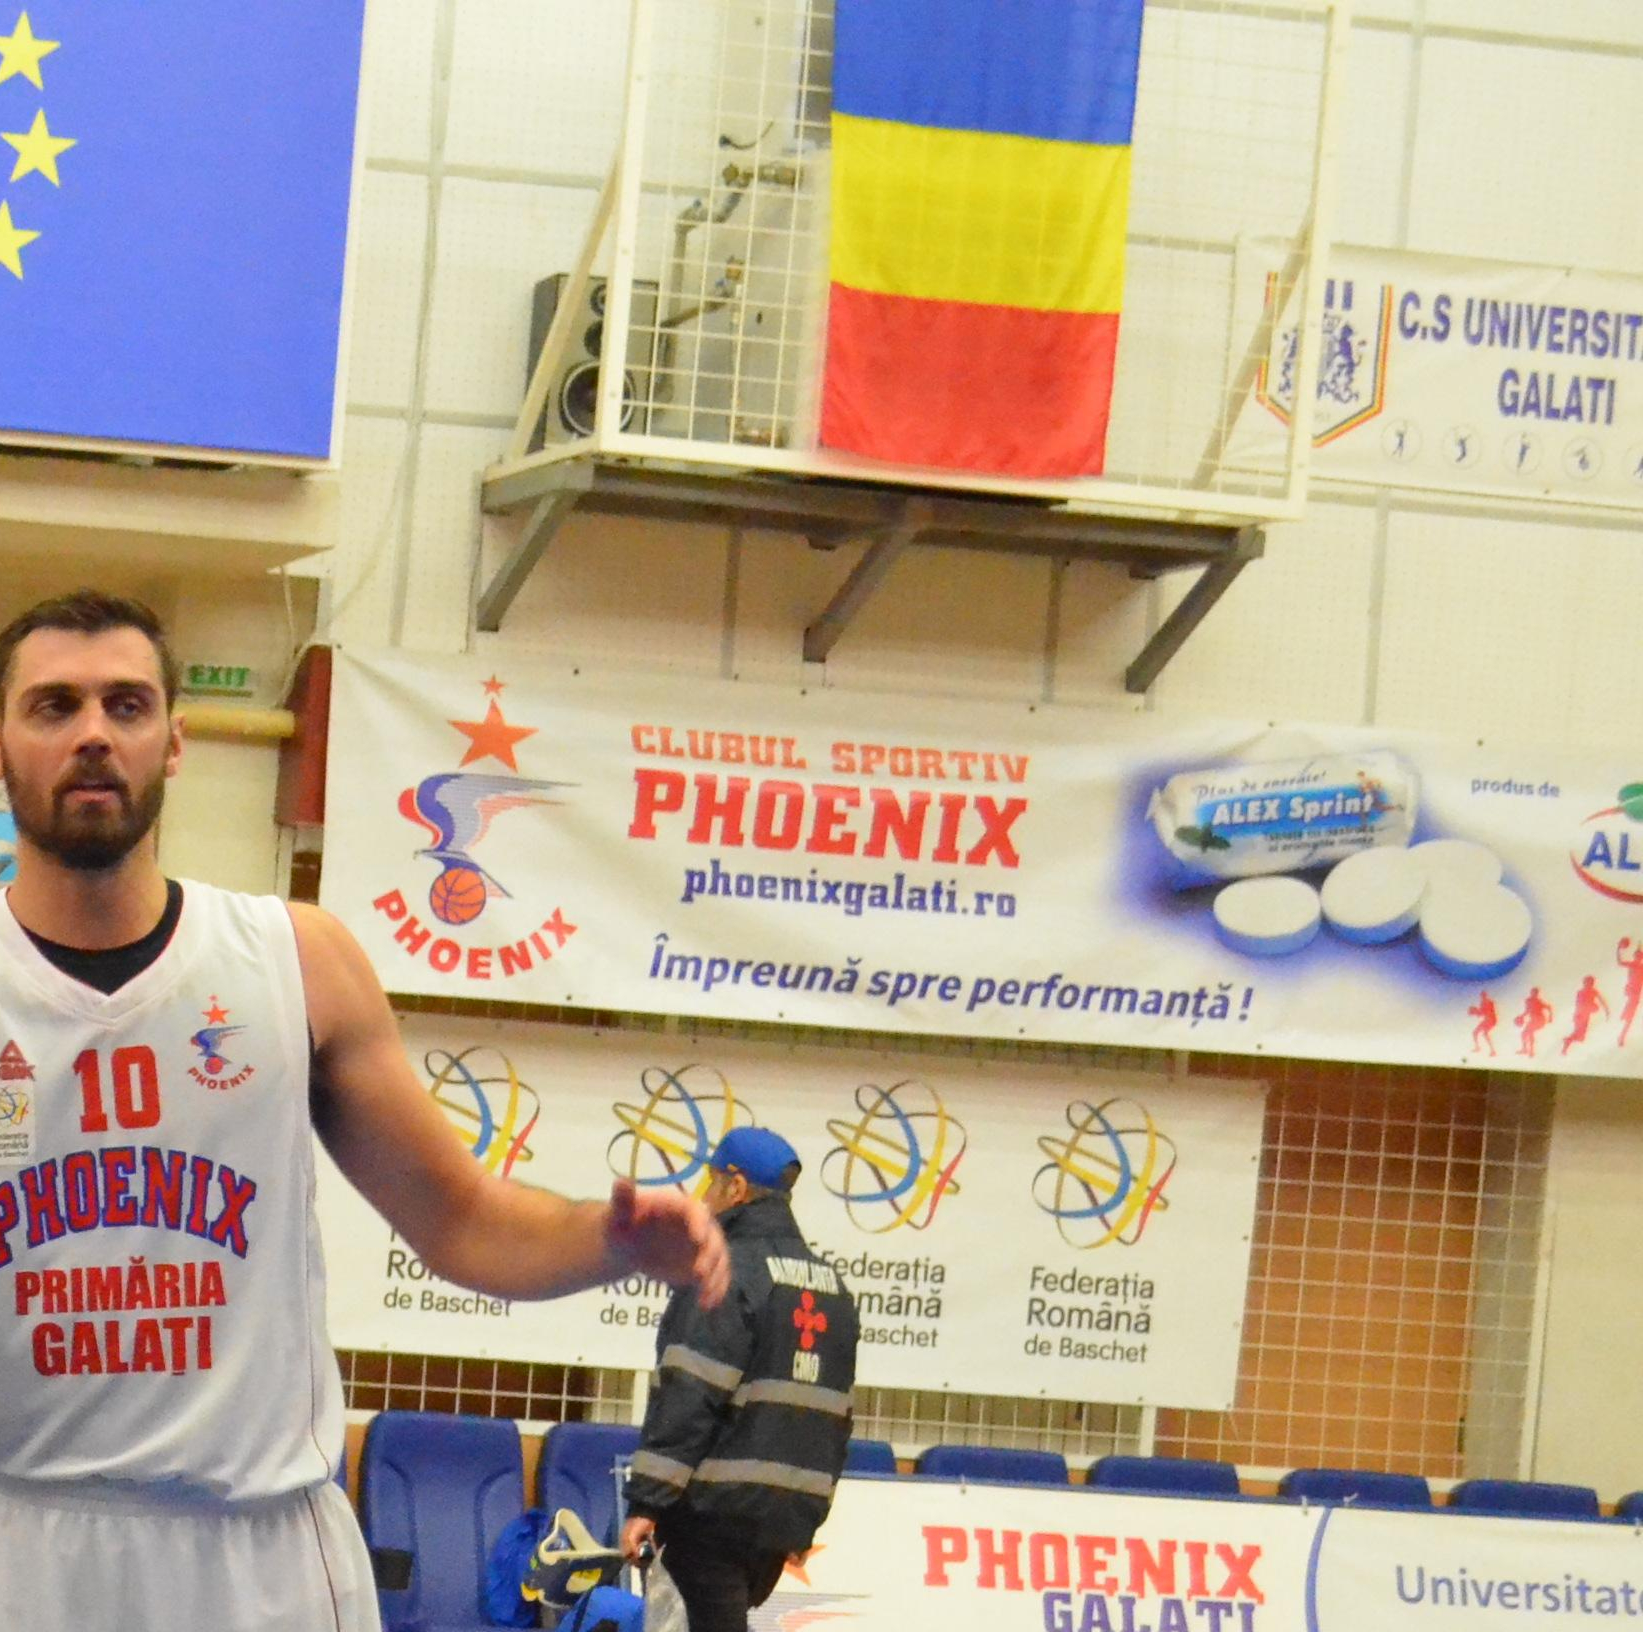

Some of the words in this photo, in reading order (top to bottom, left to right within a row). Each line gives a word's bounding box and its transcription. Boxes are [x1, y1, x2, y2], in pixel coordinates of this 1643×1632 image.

[1398, 291, 1452, 342] C.S
[1497, 368, 1617, 426] GALATI
[190, 665, 251, 687] EXIT
[631, 724, 807, 769] CLUBUL
[831, 742, 1029, 783] SPORTIV
[1212, 799, 1281, 826] ALEX
[1289, 793, 1374, 823] Sprint
[1471, 779, 1534, 795] produs
[1538, 782, 1560, 797] de
[628, 768, 1028, 869] PHOENIX
[681, 859, 1016, 917] phoenixgalati.ro
[372, 888, 578, 980] PHOENIX
[650, 933, 863, 994] Împreună
[866, 969, 962, 1006] spre
[966, 973, 1233, 1028] performanță
[72, 1044, 161, 1133] 10
[187, 1062, 257, 1091] PHOENIX
[15, 1255, 228, 1316] PRIMĂRIA
[384, 1287, 412, 1310] de
[1029, 1265, 1154, 1304] Federația
[600, 1304, 628, 1327] de
[1026, 1298, 1151, 1334] Română
[1024, 1333, 1052, 1356] de
[1059, 1336, 1148, 1363] Baschet
[922, 1525, 1266, 1606] PHOENIX
[1396, 1565, 1643, 1617] Universitat
